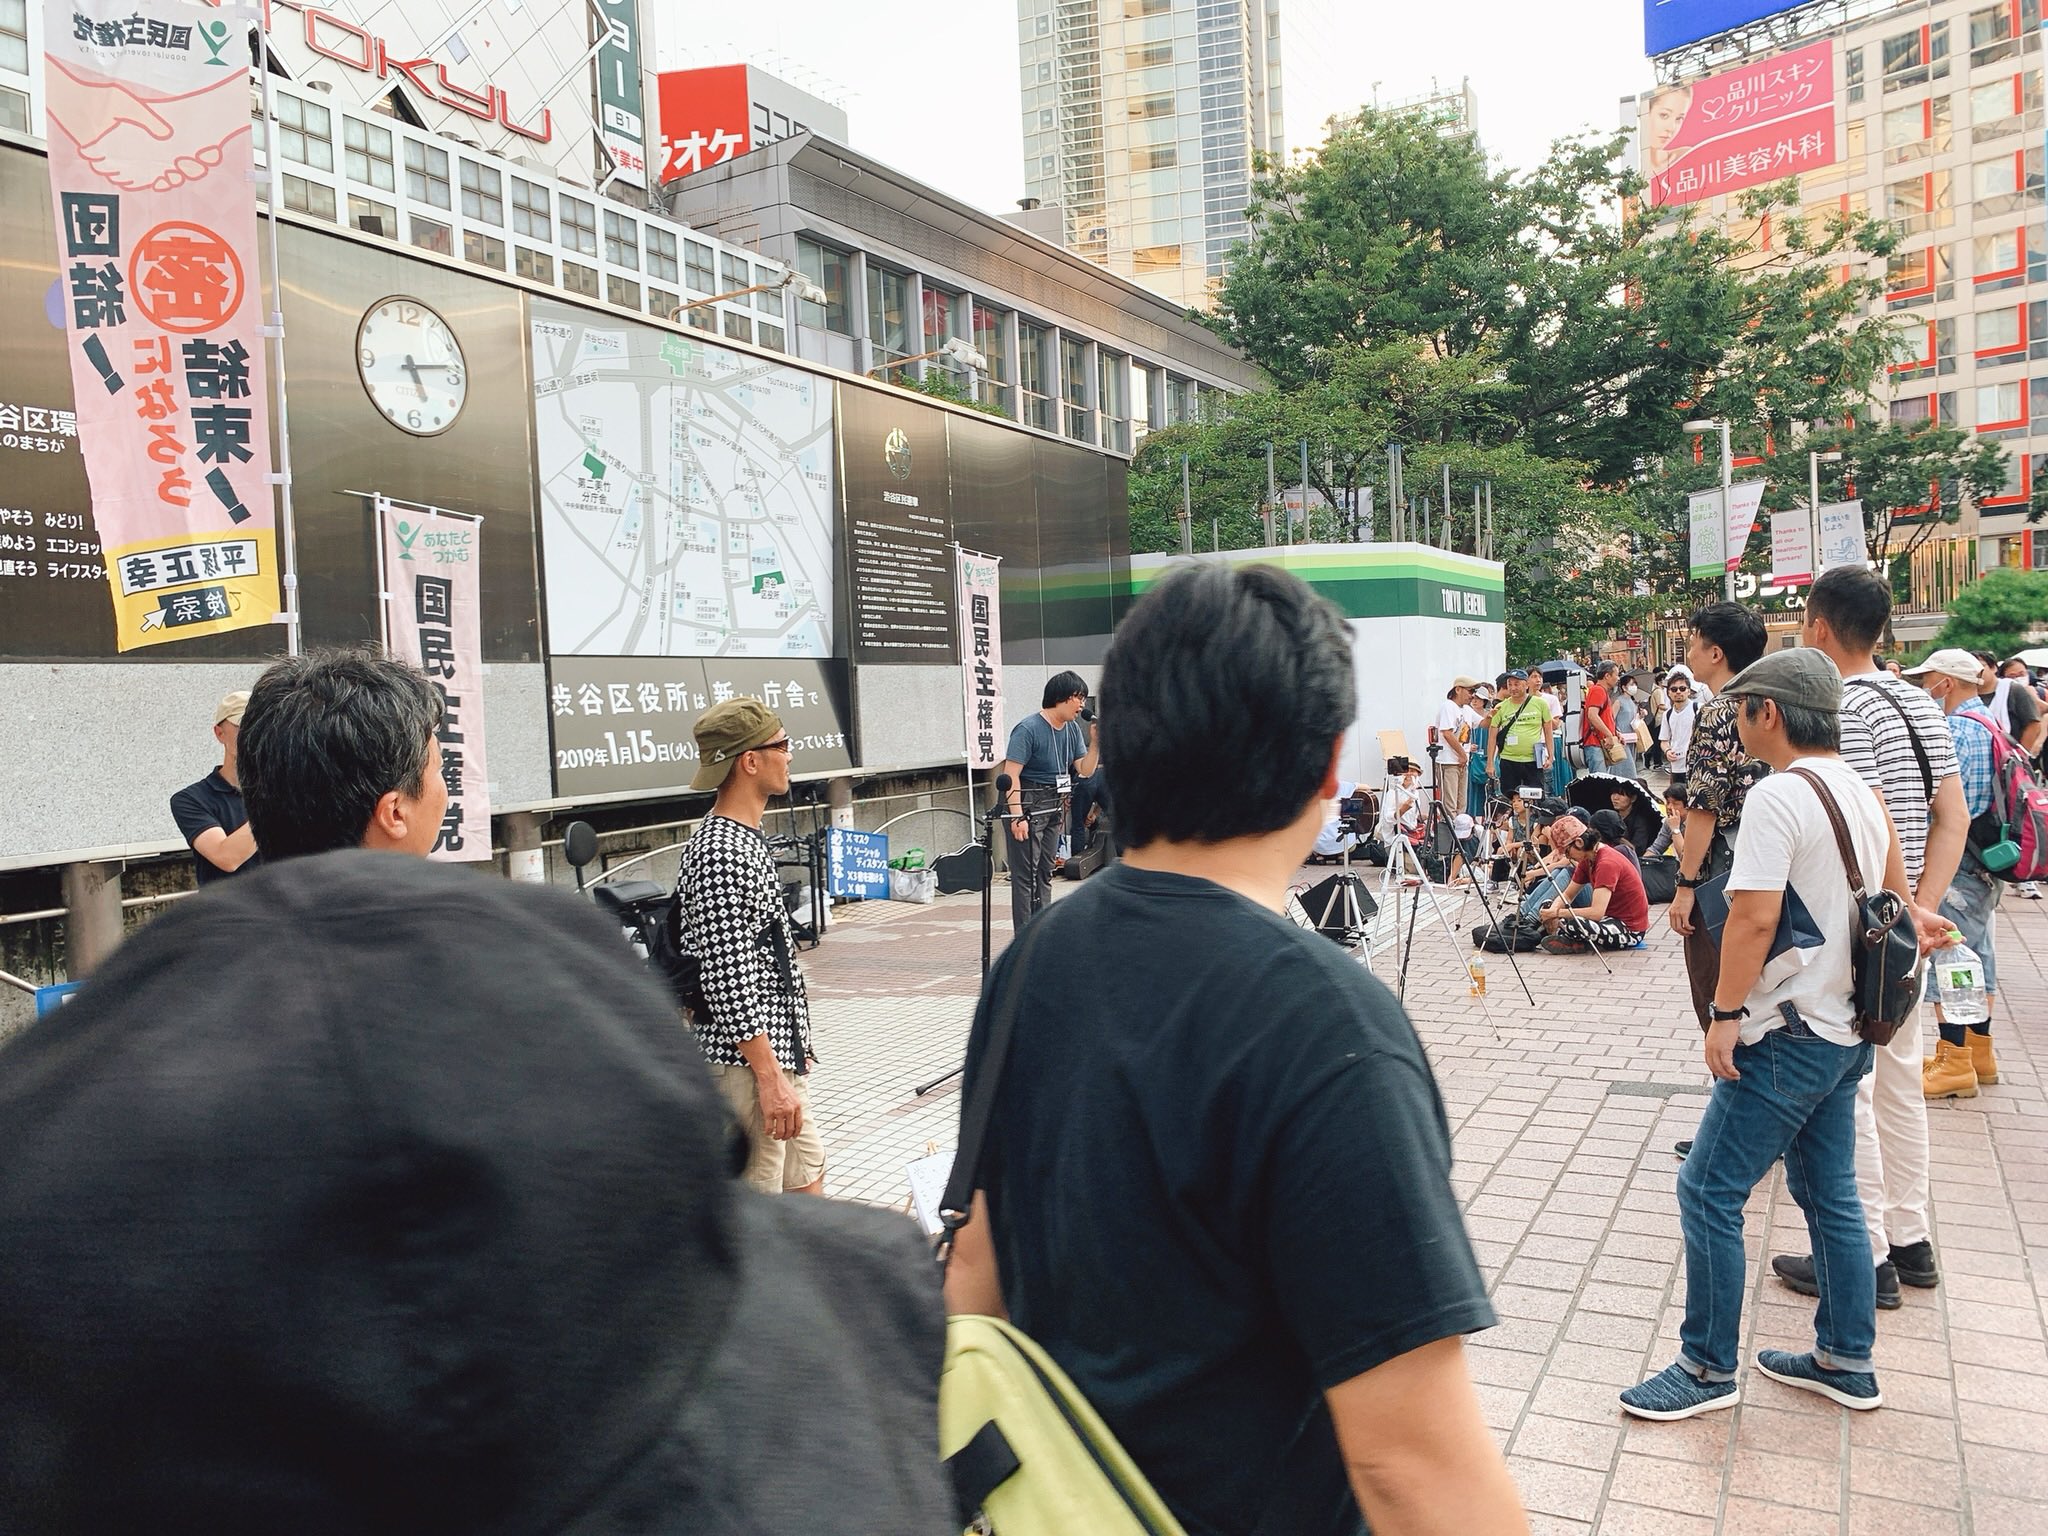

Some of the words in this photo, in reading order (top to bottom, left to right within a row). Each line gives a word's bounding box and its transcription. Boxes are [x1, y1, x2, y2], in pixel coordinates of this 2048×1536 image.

[1726, 58, 1825, 103] 品川スキン
[1727, 82, 1814, 124] クリニック
[615, 111, 631, 130] B1
[1676, 130, 1826, 195] 品川美容外科
[396, 304, 421, 327] 12
[407, 409, 422, 429] 6
[0, 434, 66, 454] のまちが
[0, 535, 36, 551] めよう
[423, 530, 473, 547] あなたと
[432, 548, 470, 564] つかむ
[1775, 545, 1808, 553] healthcare
[1785, 596, 1808, 609] CA
[971, 593, 996, 763] 国民主権党
